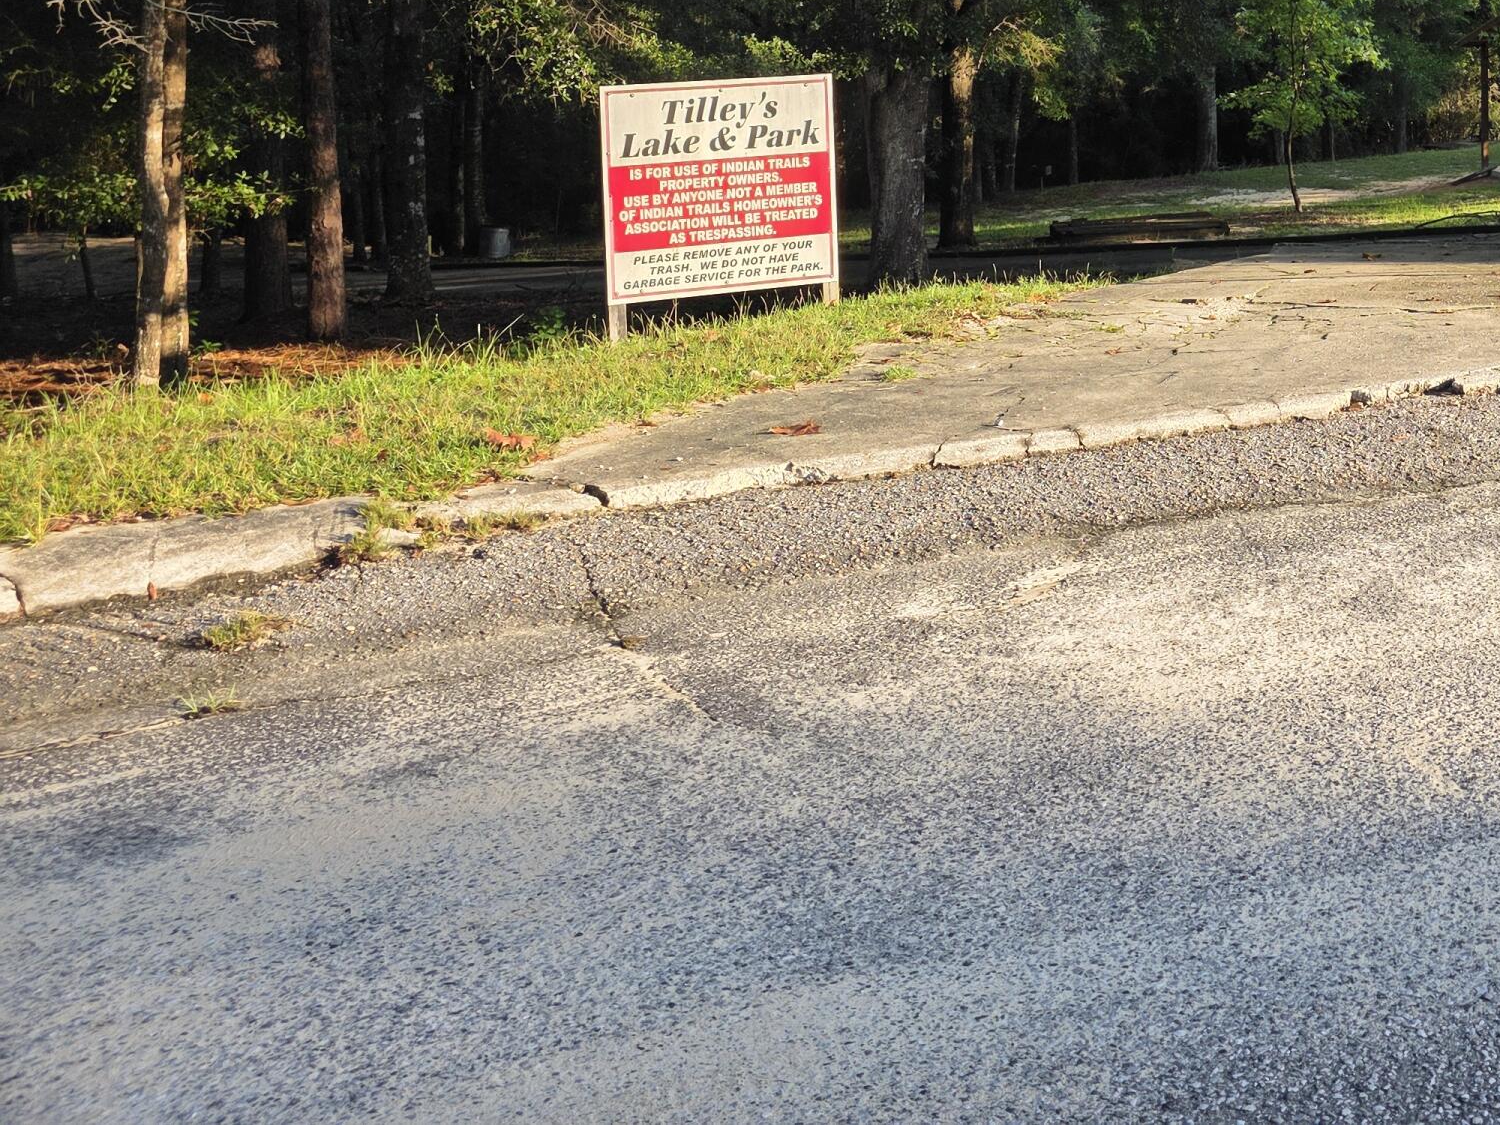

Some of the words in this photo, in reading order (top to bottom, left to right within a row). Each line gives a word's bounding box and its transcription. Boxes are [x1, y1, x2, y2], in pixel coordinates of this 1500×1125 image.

[662, 92, 779, 128] Tilley's
[620, 130, 701, 158] Lake
[709, 128, 736, 151] &
[745, 120, 820, 149] Park
[629, 169, 642, 180] IS
[646, 167, 671, 179] FOR
[674, 165, 699, 178] USE
[703, 164, 718, 175] OF
[722, 161, 764, 173] INDIAN
[768, 157, 810, 170] TRAILS
[660, 178, 725, 191] PROPERTY
[728, 172, 783, 185] OWNERS.
[624, 195, 649, 207] USE
[653, 194, 669, 205] BY
[672, 189, 723, 204] ANYONE
[726, 188, 750, 199] NOT
[754, 186, 763, 197] A
[766, 182, 817, 196] MEMBER
[619, 210, 637, 222] OF
[640, 206, 683, 219] INDIAN
[687, 203, 730, 216] TRAILS
[734, 194, 822, 212] HOMEOWNER'S
[625, 218, 709, 235] ASSOCIATION
[712, 214, 741, 226] WILL
[745, 212, 760, 223] BE
[764, 208, 817, 221] TREATED
[669, 232, 686, 244] AS
[689, 225, 776, 242] TRESPASSING.
[634, 253, 679, 265] PLEASE
[684, 248, 732, 260] REMOVE
[735, 245, 760, 255] ANY
[763, 243, 779, 253] OF
[782, 240, 813, 251] YOUR
[650, 263, 693, 275] TRASH.
[701, 260, 719, 270] WE
[722, 258, 738, 268] DO
[742, 255, 766, 266] NOT
[769, 252, 799, 263] HAVE
[624, 276, 680, 290] GARBAGE
[684, 271, 734, 283] SERVICE
[739, 267, 761, 278] FOR
[765, 265, 788, 275] THE
[791, 261, 823, 273] PARK.
